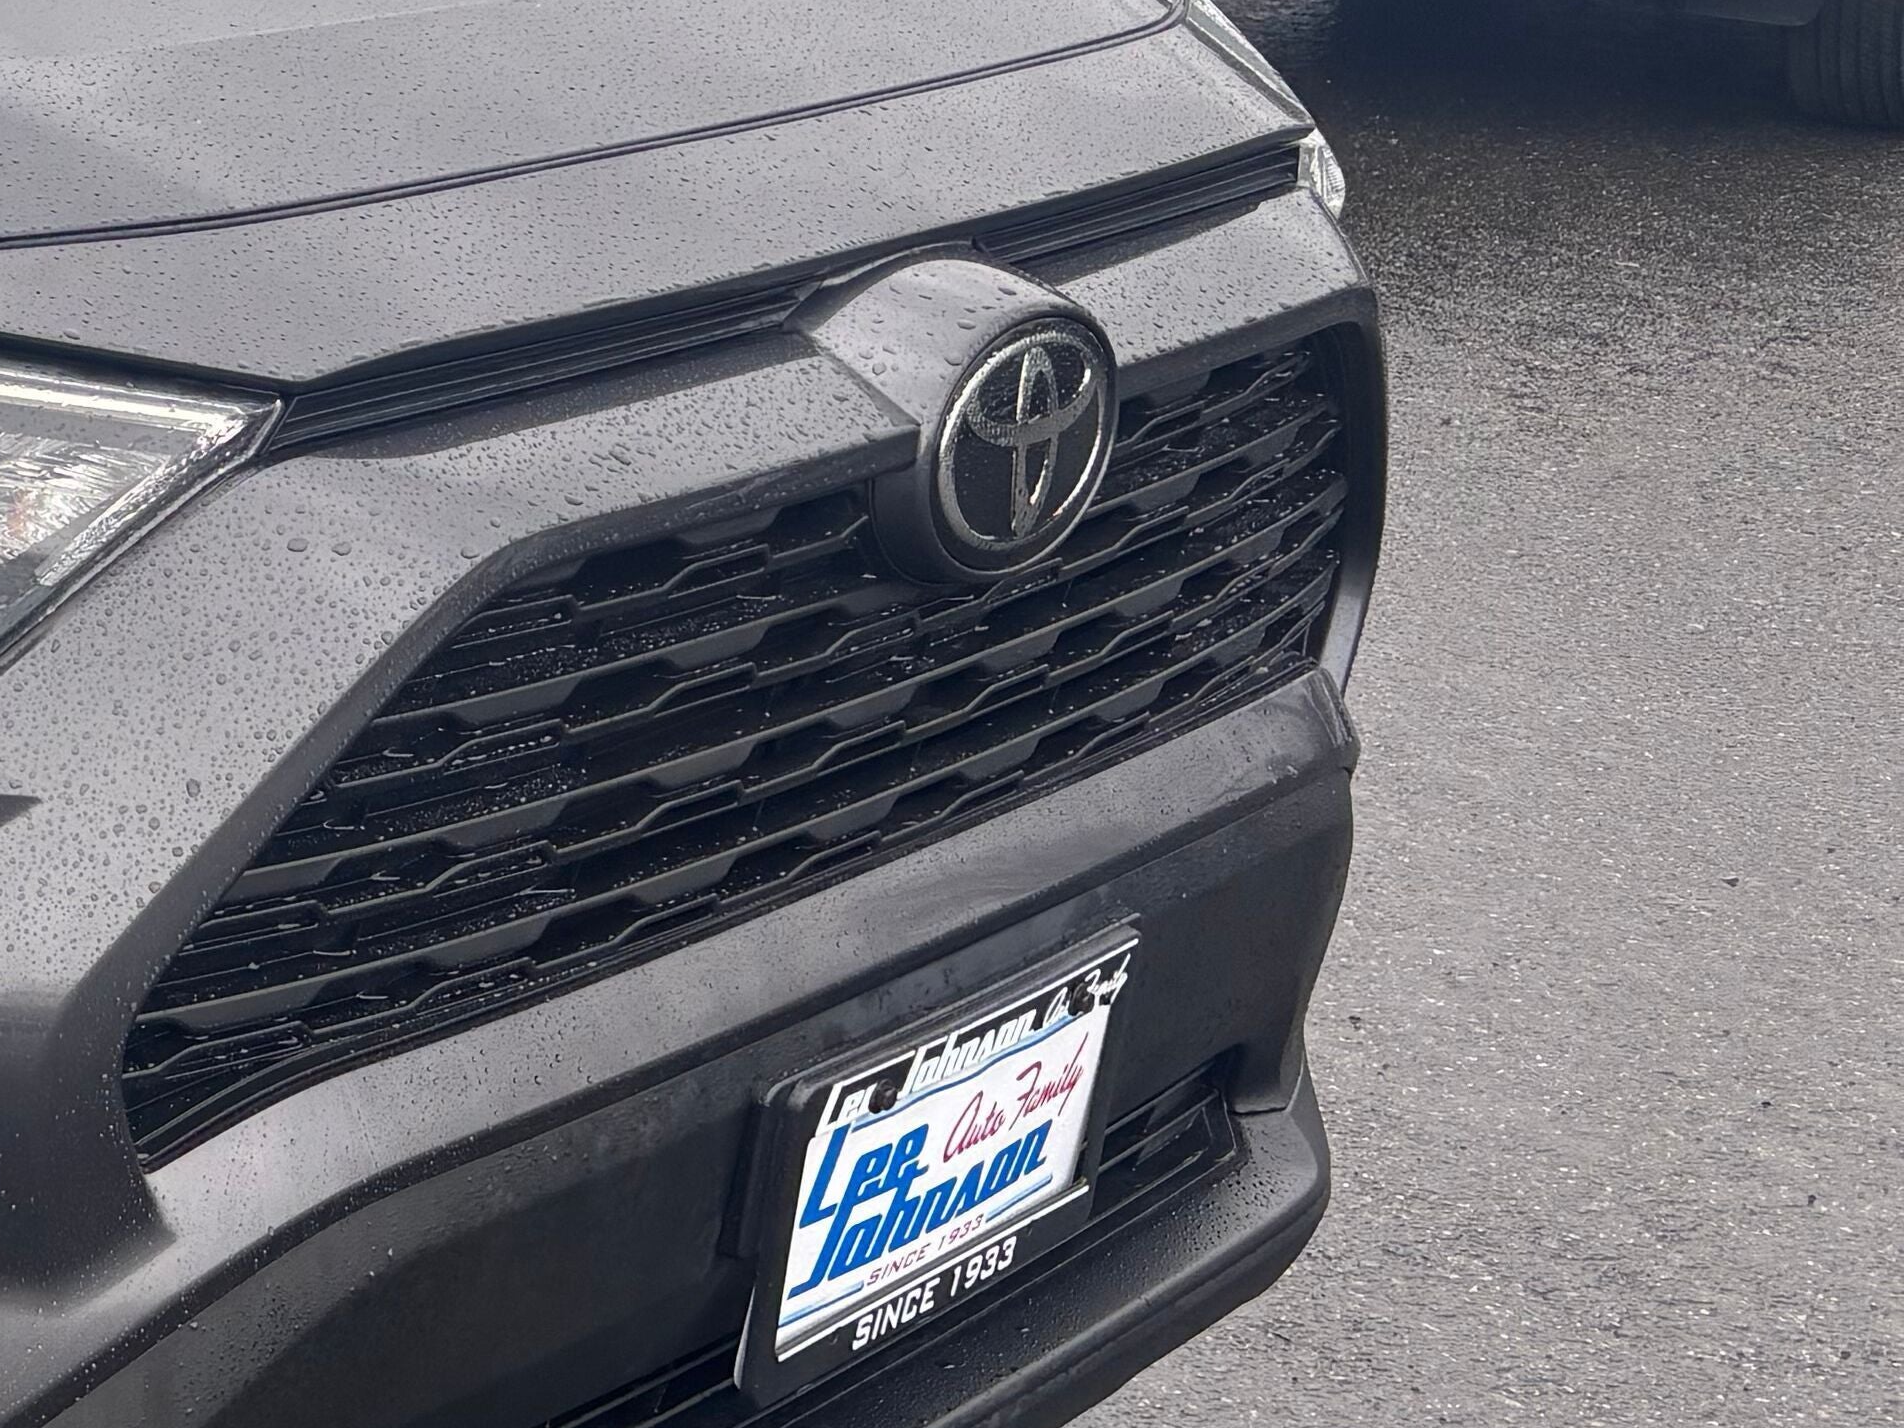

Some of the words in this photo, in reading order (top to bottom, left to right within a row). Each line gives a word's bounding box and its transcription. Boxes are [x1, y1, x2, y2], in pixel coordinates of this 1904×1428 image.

[896, 1008, 1036, 1102] Johnson
[799, 1123, 929, 1229] Lee
[942, 1091, 1005, 1163] Auto
[1008, 1032, 1089, 1130] Family
[787, 1118, 1053, 1300] Johnson
[867, 1243, 930, 1286] SINCE
[937, 1213, 984, 1251] 1933
[852, 1277, 940, 1351] SINCE
[950, 1235, 1017, 1297] 1933
